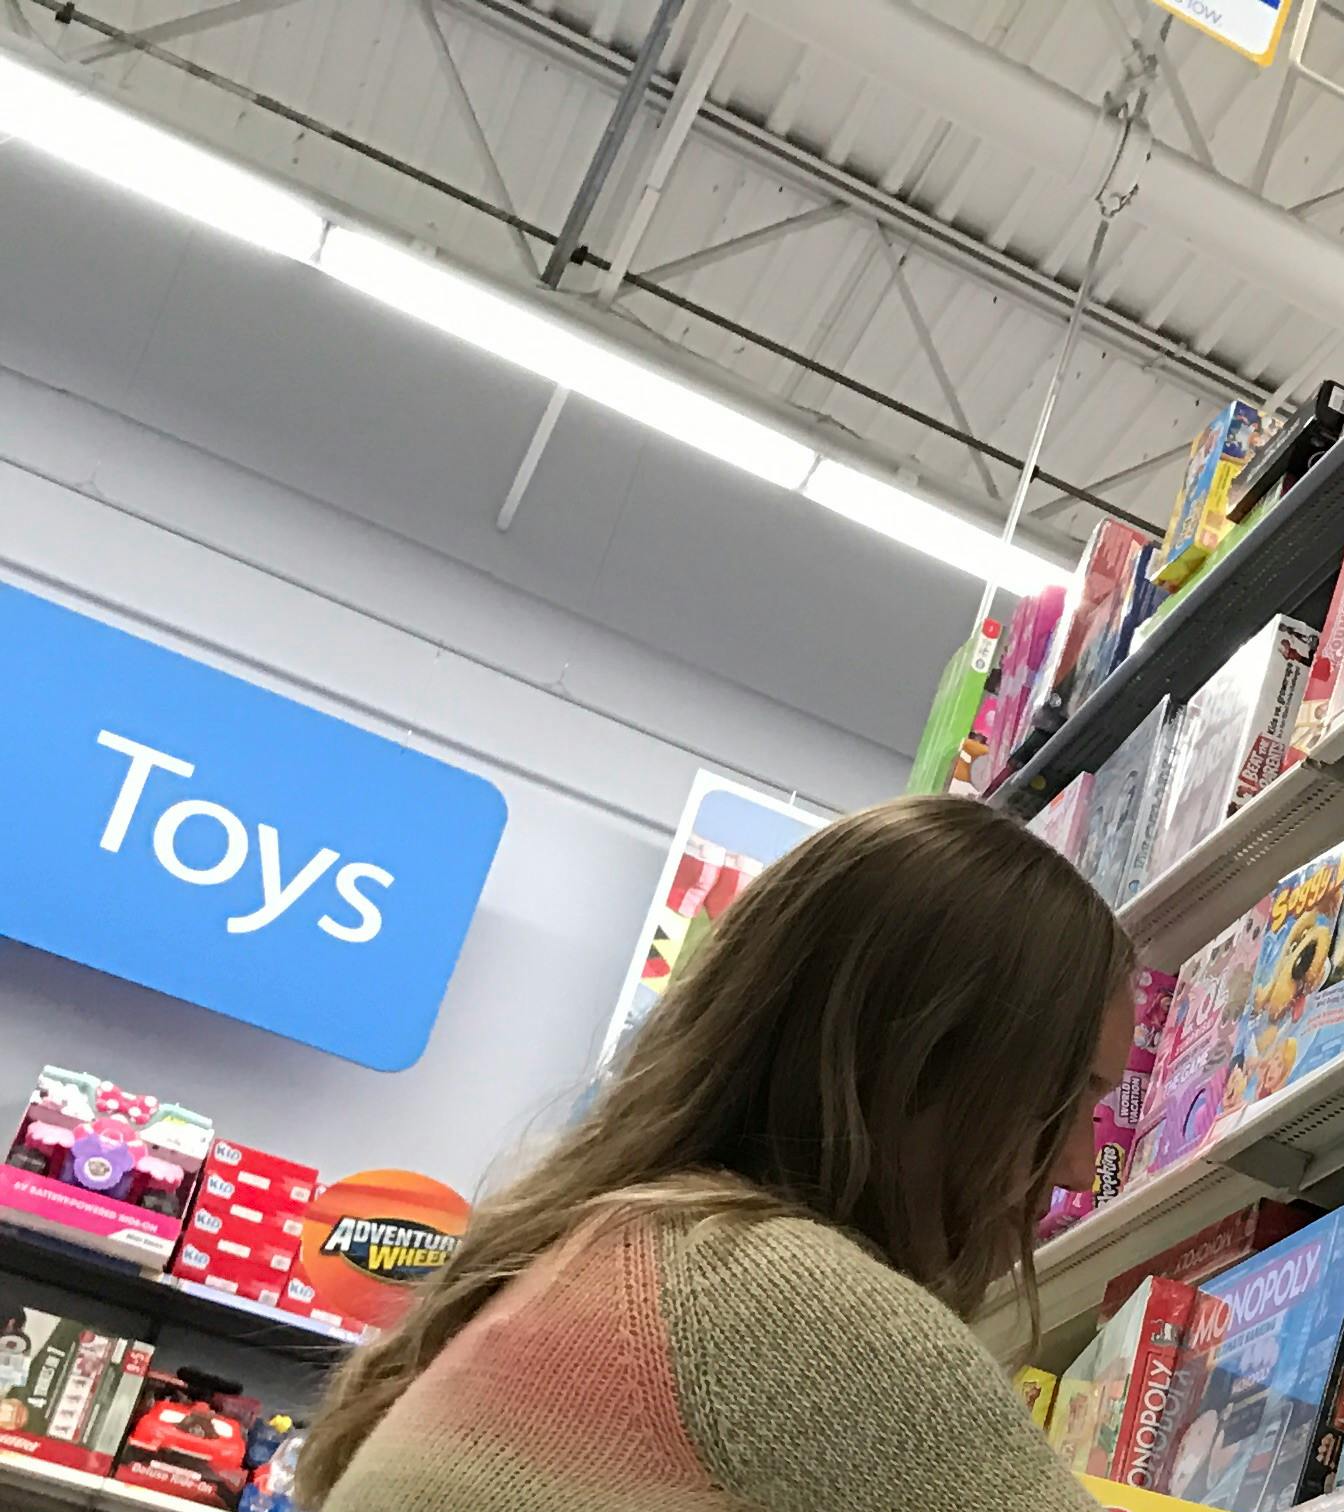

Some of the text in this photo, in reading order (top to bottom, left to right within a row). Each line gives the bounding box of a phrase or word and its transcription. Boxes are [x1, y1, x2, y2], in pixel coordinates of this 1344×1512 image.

[1241, 752, 1266, 785] BEAT
[97, 730, 394, 943] Toys
[1119, 1083, 1132, 1117] WORLD
[1128, 1076, 1142, 1125] VACATION
[1191, 1244, 1322, 1349] MONOPOLY
[1126, 1359, 1174, 1488] ONOPOLY
